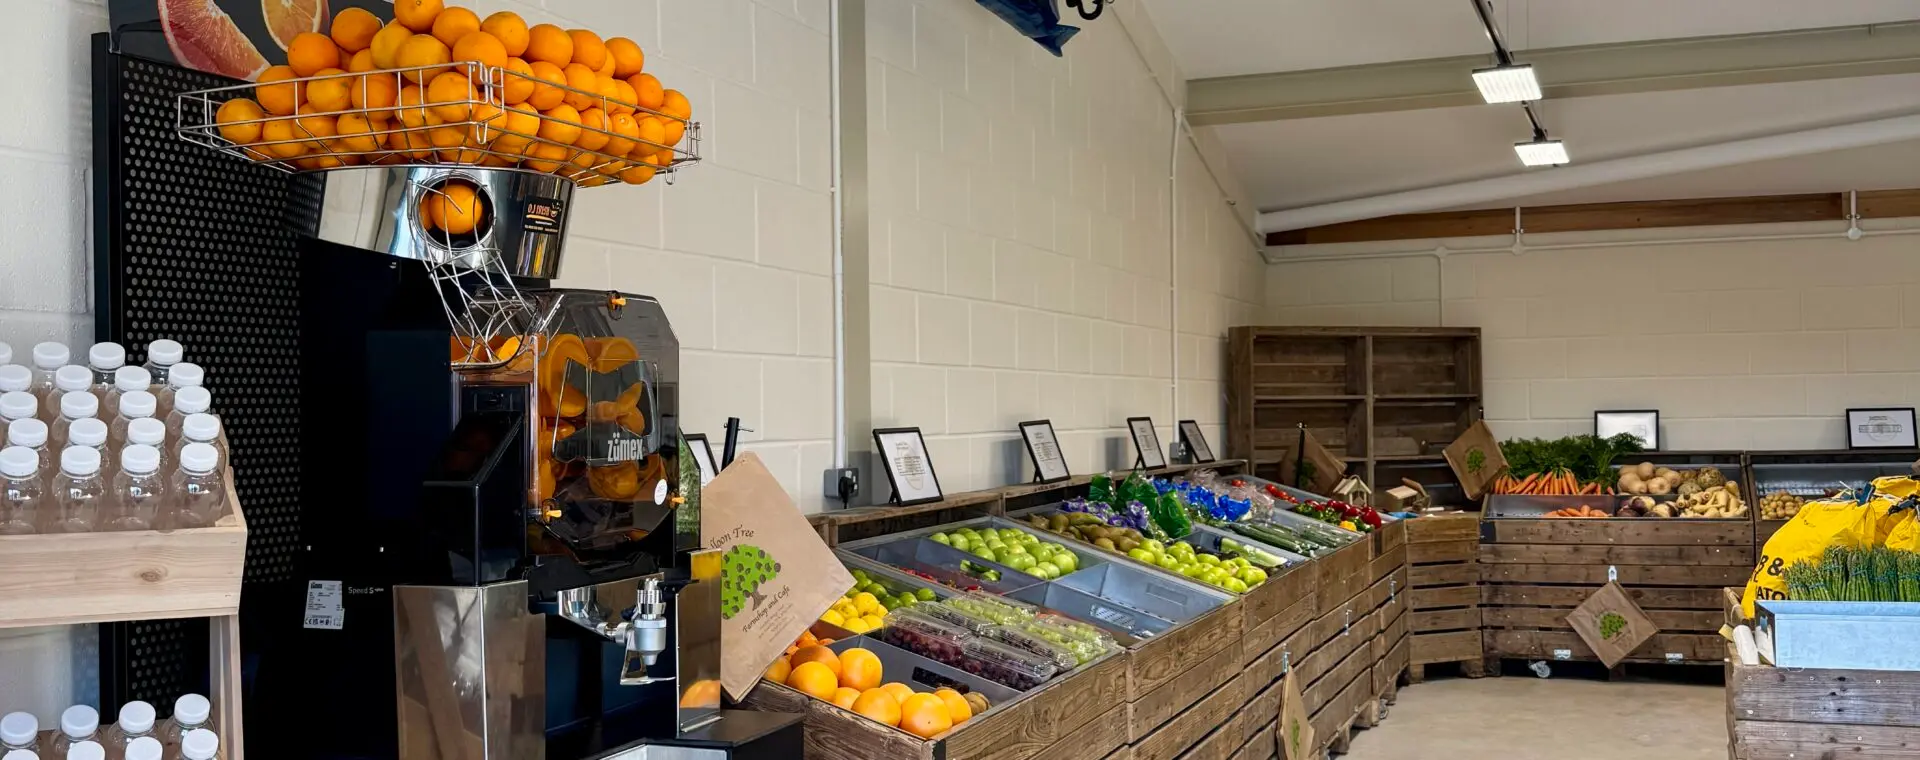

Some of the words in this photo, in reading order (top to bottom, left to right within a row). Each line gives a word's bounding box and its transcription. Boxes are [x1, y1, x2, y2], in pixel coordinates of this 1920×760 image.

[732, 524, 755, 538] Tree
[1767, 557, 1784, 577] &
[348, 586, 368, 595] Speed
[1755, 585, 1790, 601] ATO
[742, 608, 769, 633] Farmshop
[767, 592, 779, 609] and
